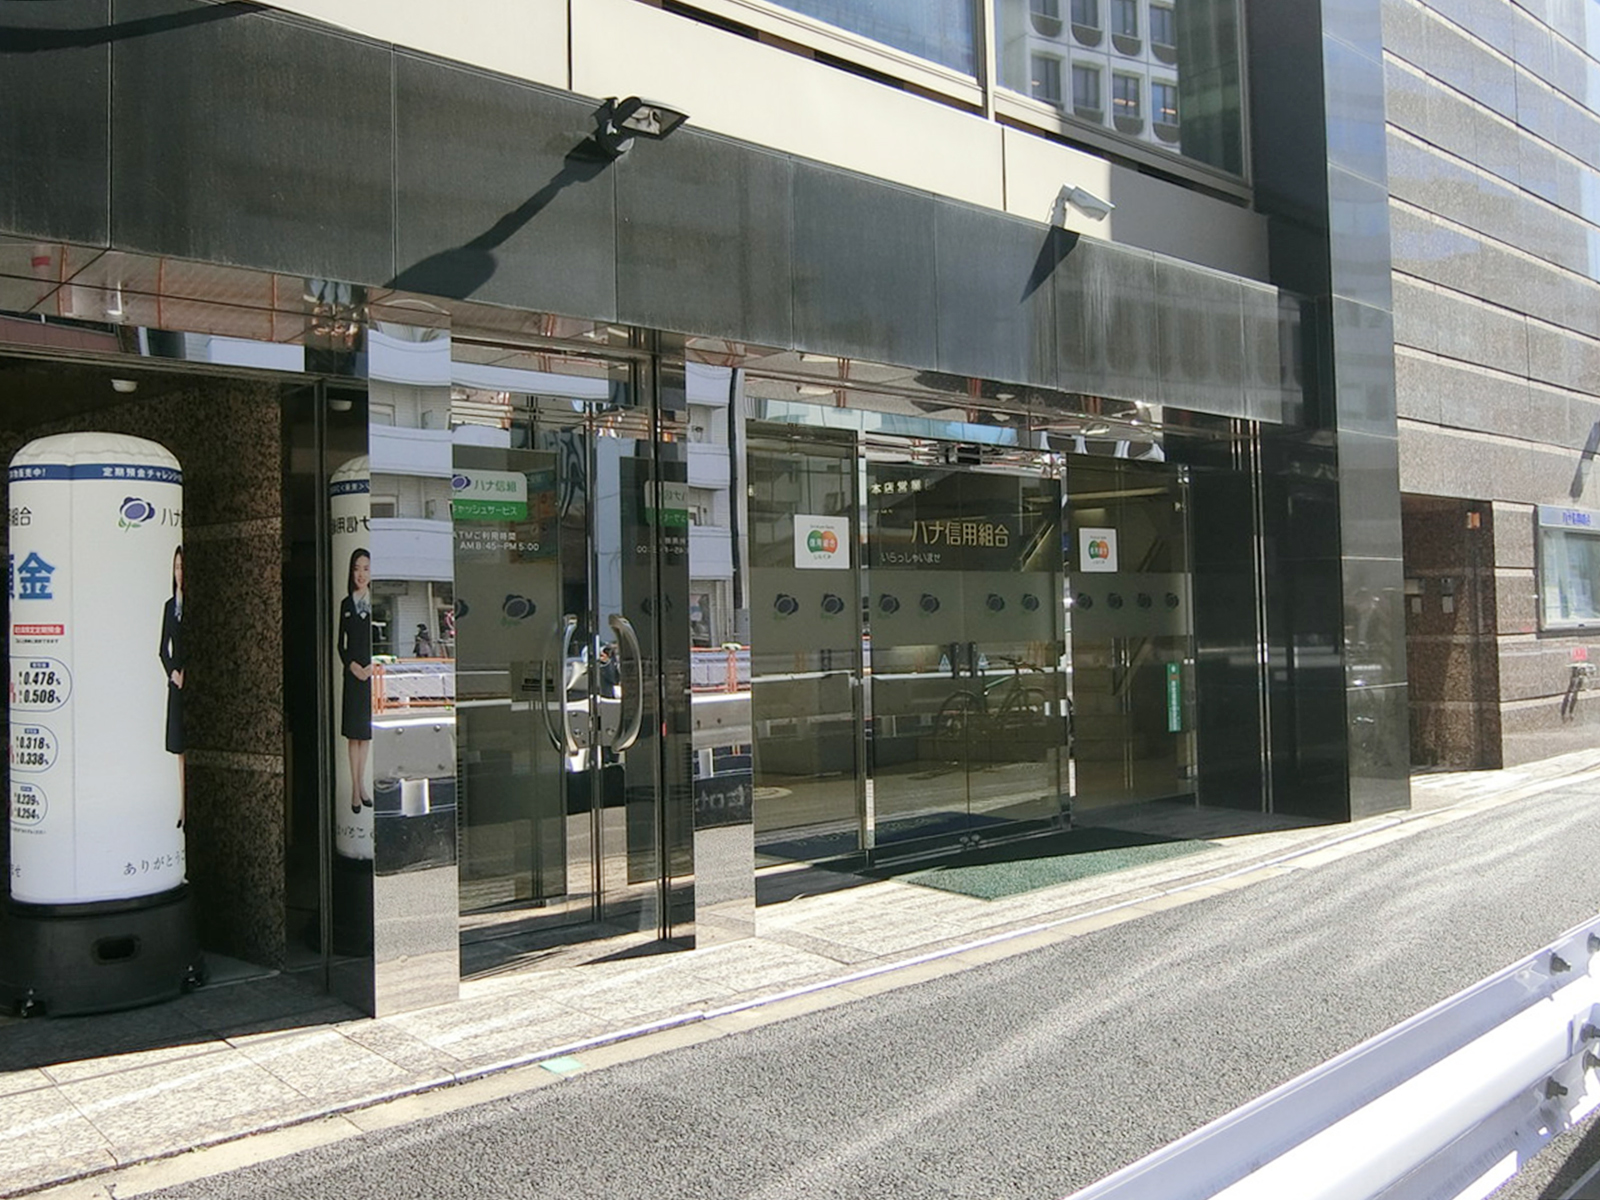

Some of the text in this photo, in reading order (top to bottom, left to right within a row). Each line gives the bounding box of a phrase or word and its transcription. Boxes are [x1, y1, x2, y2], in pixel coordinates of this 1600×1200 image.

[911, 520, 1009, 547] ハナ信用組合
[881, 552, 941, 564] いらっしゃいませ
